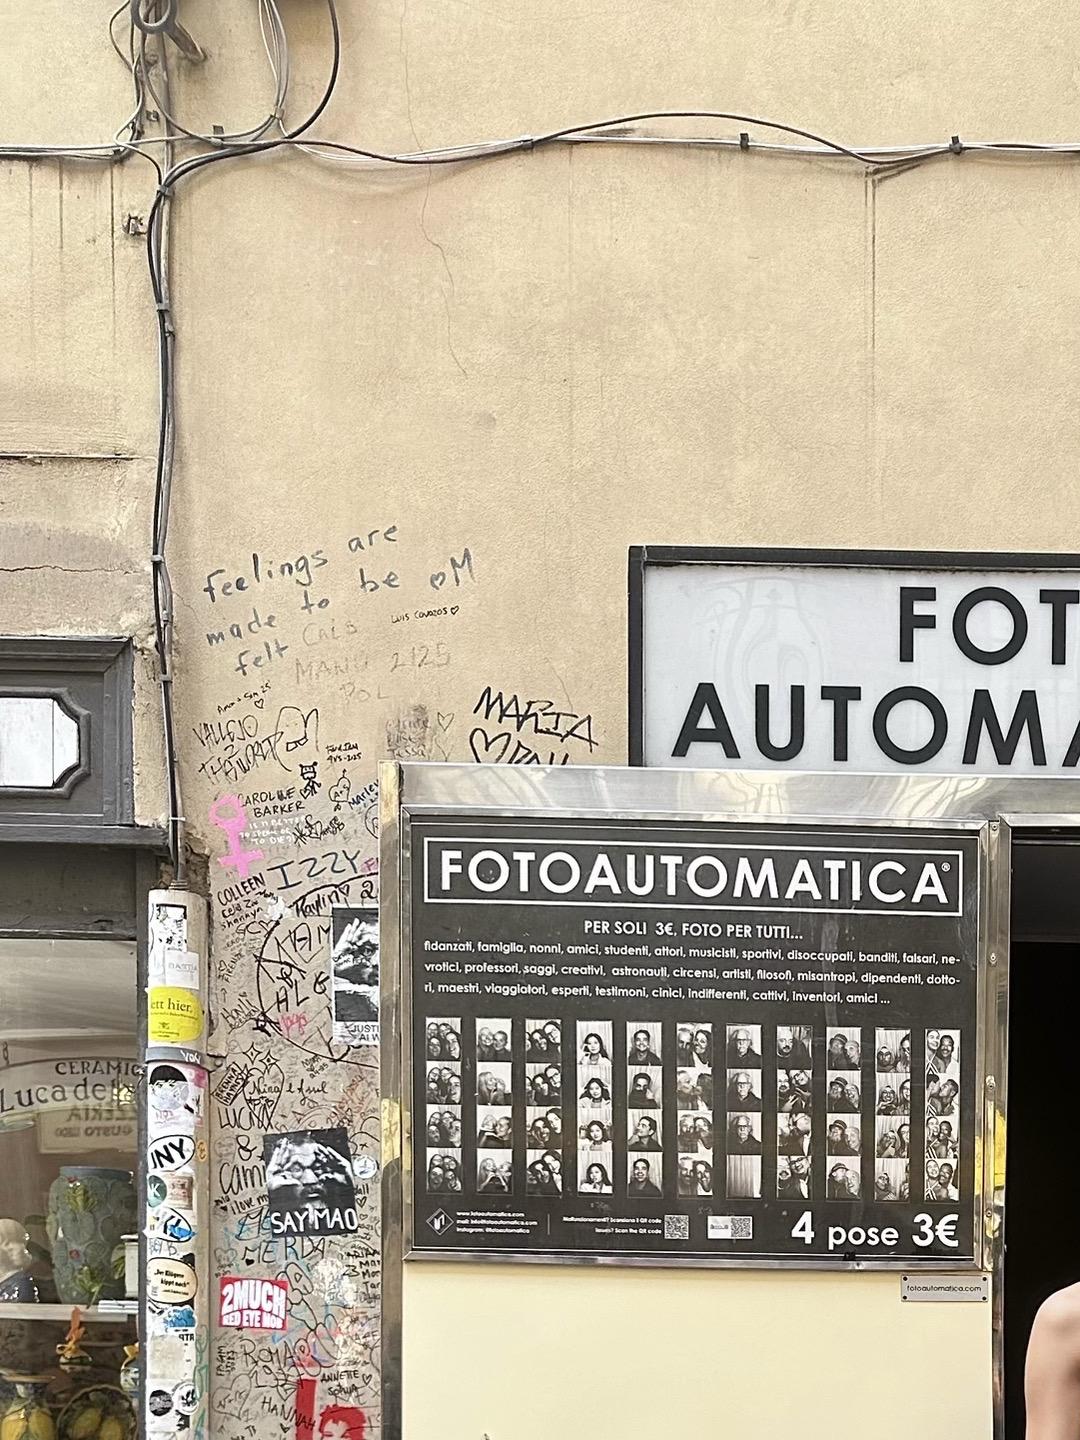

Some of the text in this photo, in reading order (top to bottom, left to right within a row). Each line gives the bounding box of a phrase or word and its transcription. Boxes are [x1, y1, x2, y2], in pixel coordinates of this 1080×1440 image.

[348, 524, 398, 553] are
[206, 568, 400, 647] made to be
[253, 801, 305, 818] BARKER
[267, 850, 361, 891] IZZY
[584, 920, 609, 935] PER
[614, 921, 646, 936] SOLI
[682, 923, 722, 937] FOTO
[727, 924, 751, 938] PER
[756, 925, 803, 940] TUTTI...
[424, 941, 960, 965] fidanzati, famiglia, nonni, amici, studenti, attori, musicisti, sportivi, disoccupati, banditi, falsari, ne-
[424, 962, 462, 974] vrotici,
[464, 962, 521, 975] professori,
[561, 964, 606, 977] creativi,
[611, 965, 670, 978] astronauti,
[673, 966, 719, 979] circensi,
[722, 968, 754, 980] artisti,
[757, 968, 795, 981] filosofi,
[797, 970, 859, 984] misantropi,
[861, 972, 924, 986] dipendenti,
[927, 973, 960, 985] dotto-
[424, 982, 877, 1004] ri, maestri, viaggiatori, esperti, testimoni, cinici, indifferenti, cattivi, inventori, amici
[791, 1211, 959, 1250] 4 pose 3€
[221, 1280, 287, 1318] 2MUCH
[907, 1285, 982, 1293] fotoautomatica.com
